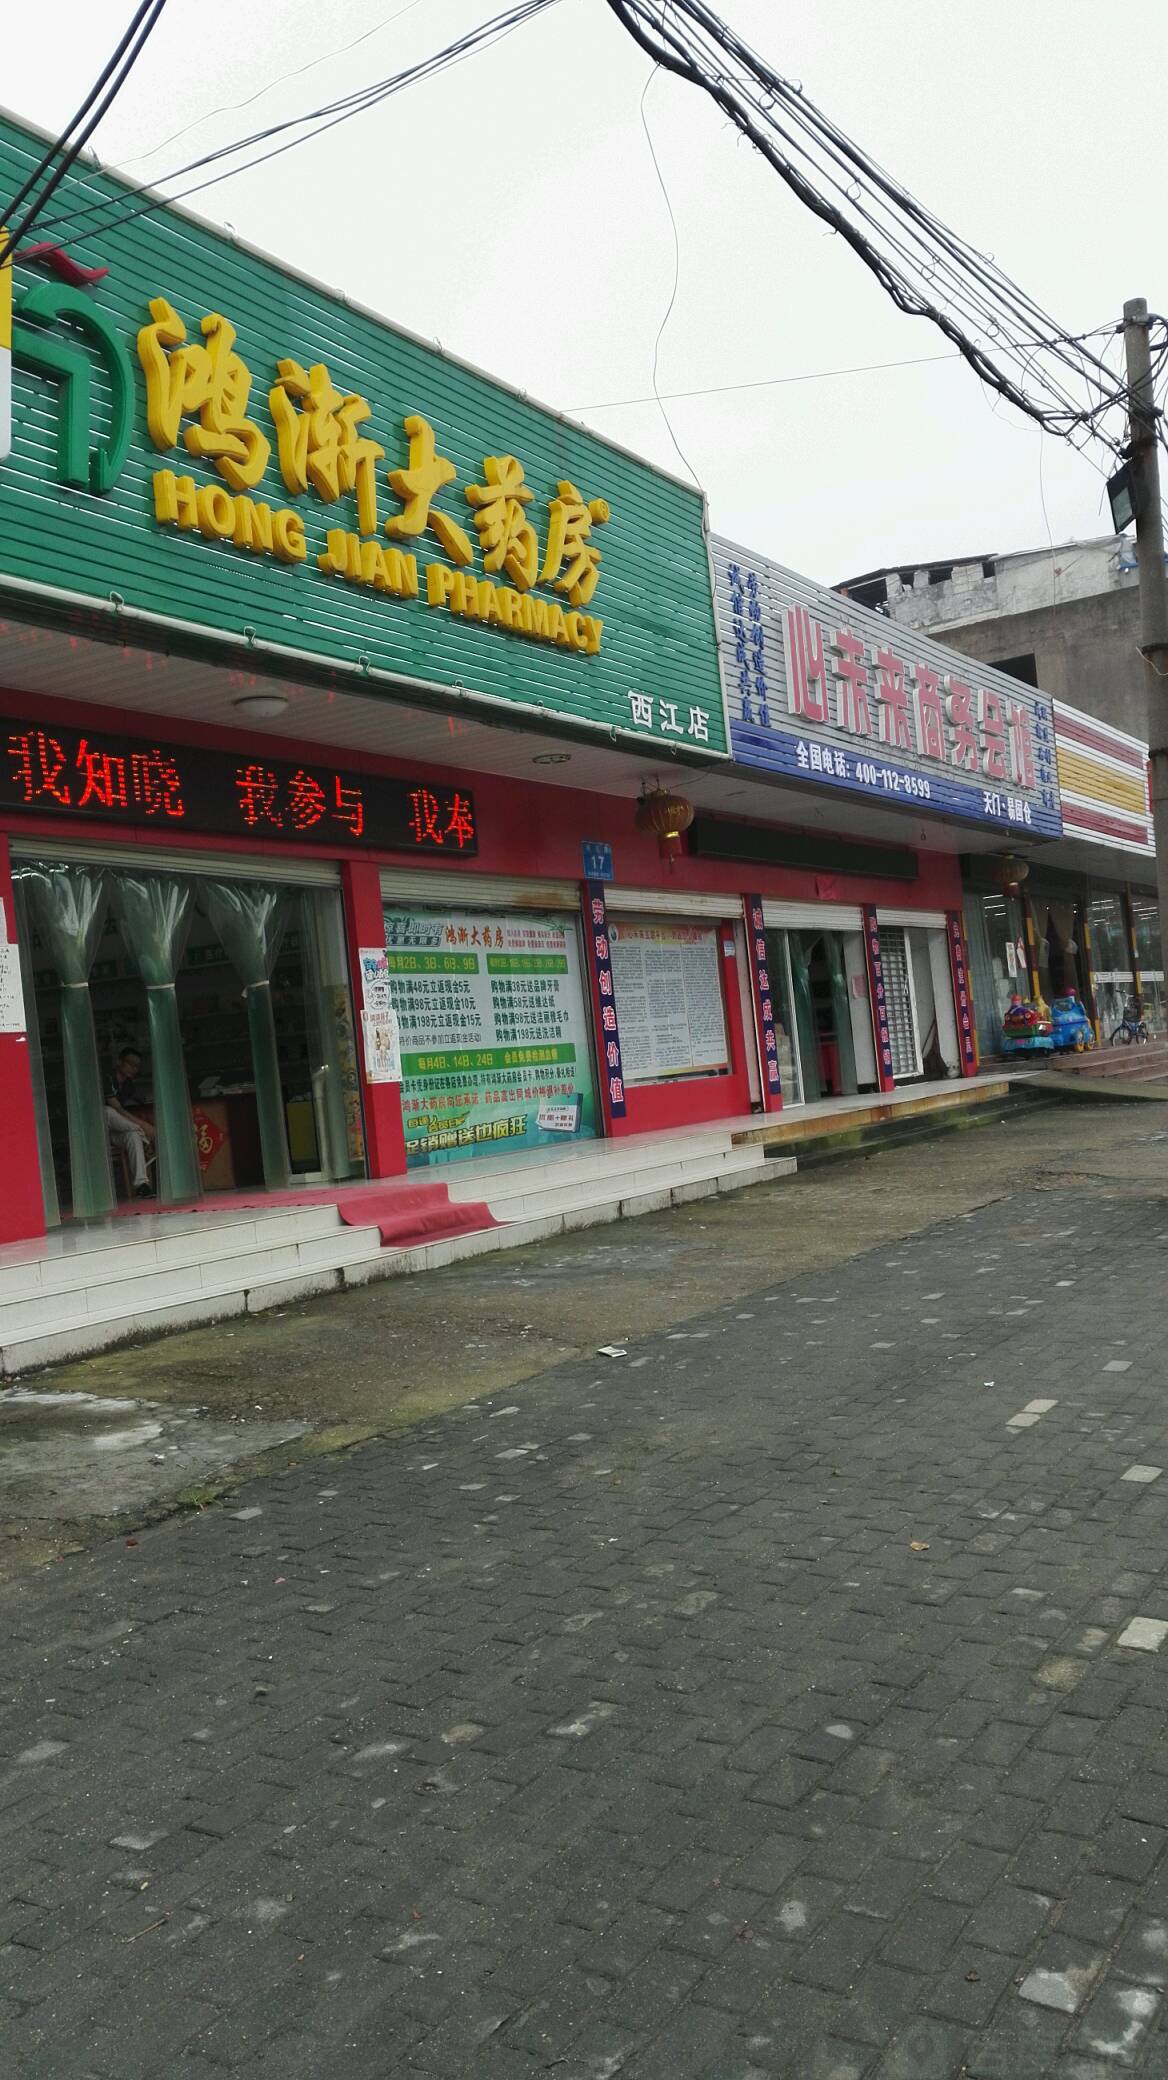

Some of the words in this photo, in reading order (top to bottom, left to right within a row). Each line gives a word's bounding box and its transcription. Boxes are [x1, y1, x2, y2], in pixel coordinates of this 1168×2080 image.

[138, 297, 604, 608] 鸿渐大药房
[153, 469, 307, 564] HONG
[317, 528, 419, 600] JIAN
[426, 564, 604, 656] PHARMACY
[628, 690, 711, 741] 西江店
[7, 731, 184, 817] 我知晓
[235, 765, 364, 837] 我参与
[856, 762, 930, 799] 400-112-8599
[592, 856, 604, 870] 17
[445, 924, 504, 948] 鸿渐大药房
[592, 898, 623, 1103] 劳动创造价值
[752, 908, 779, 1082] 诚信达成共赢
